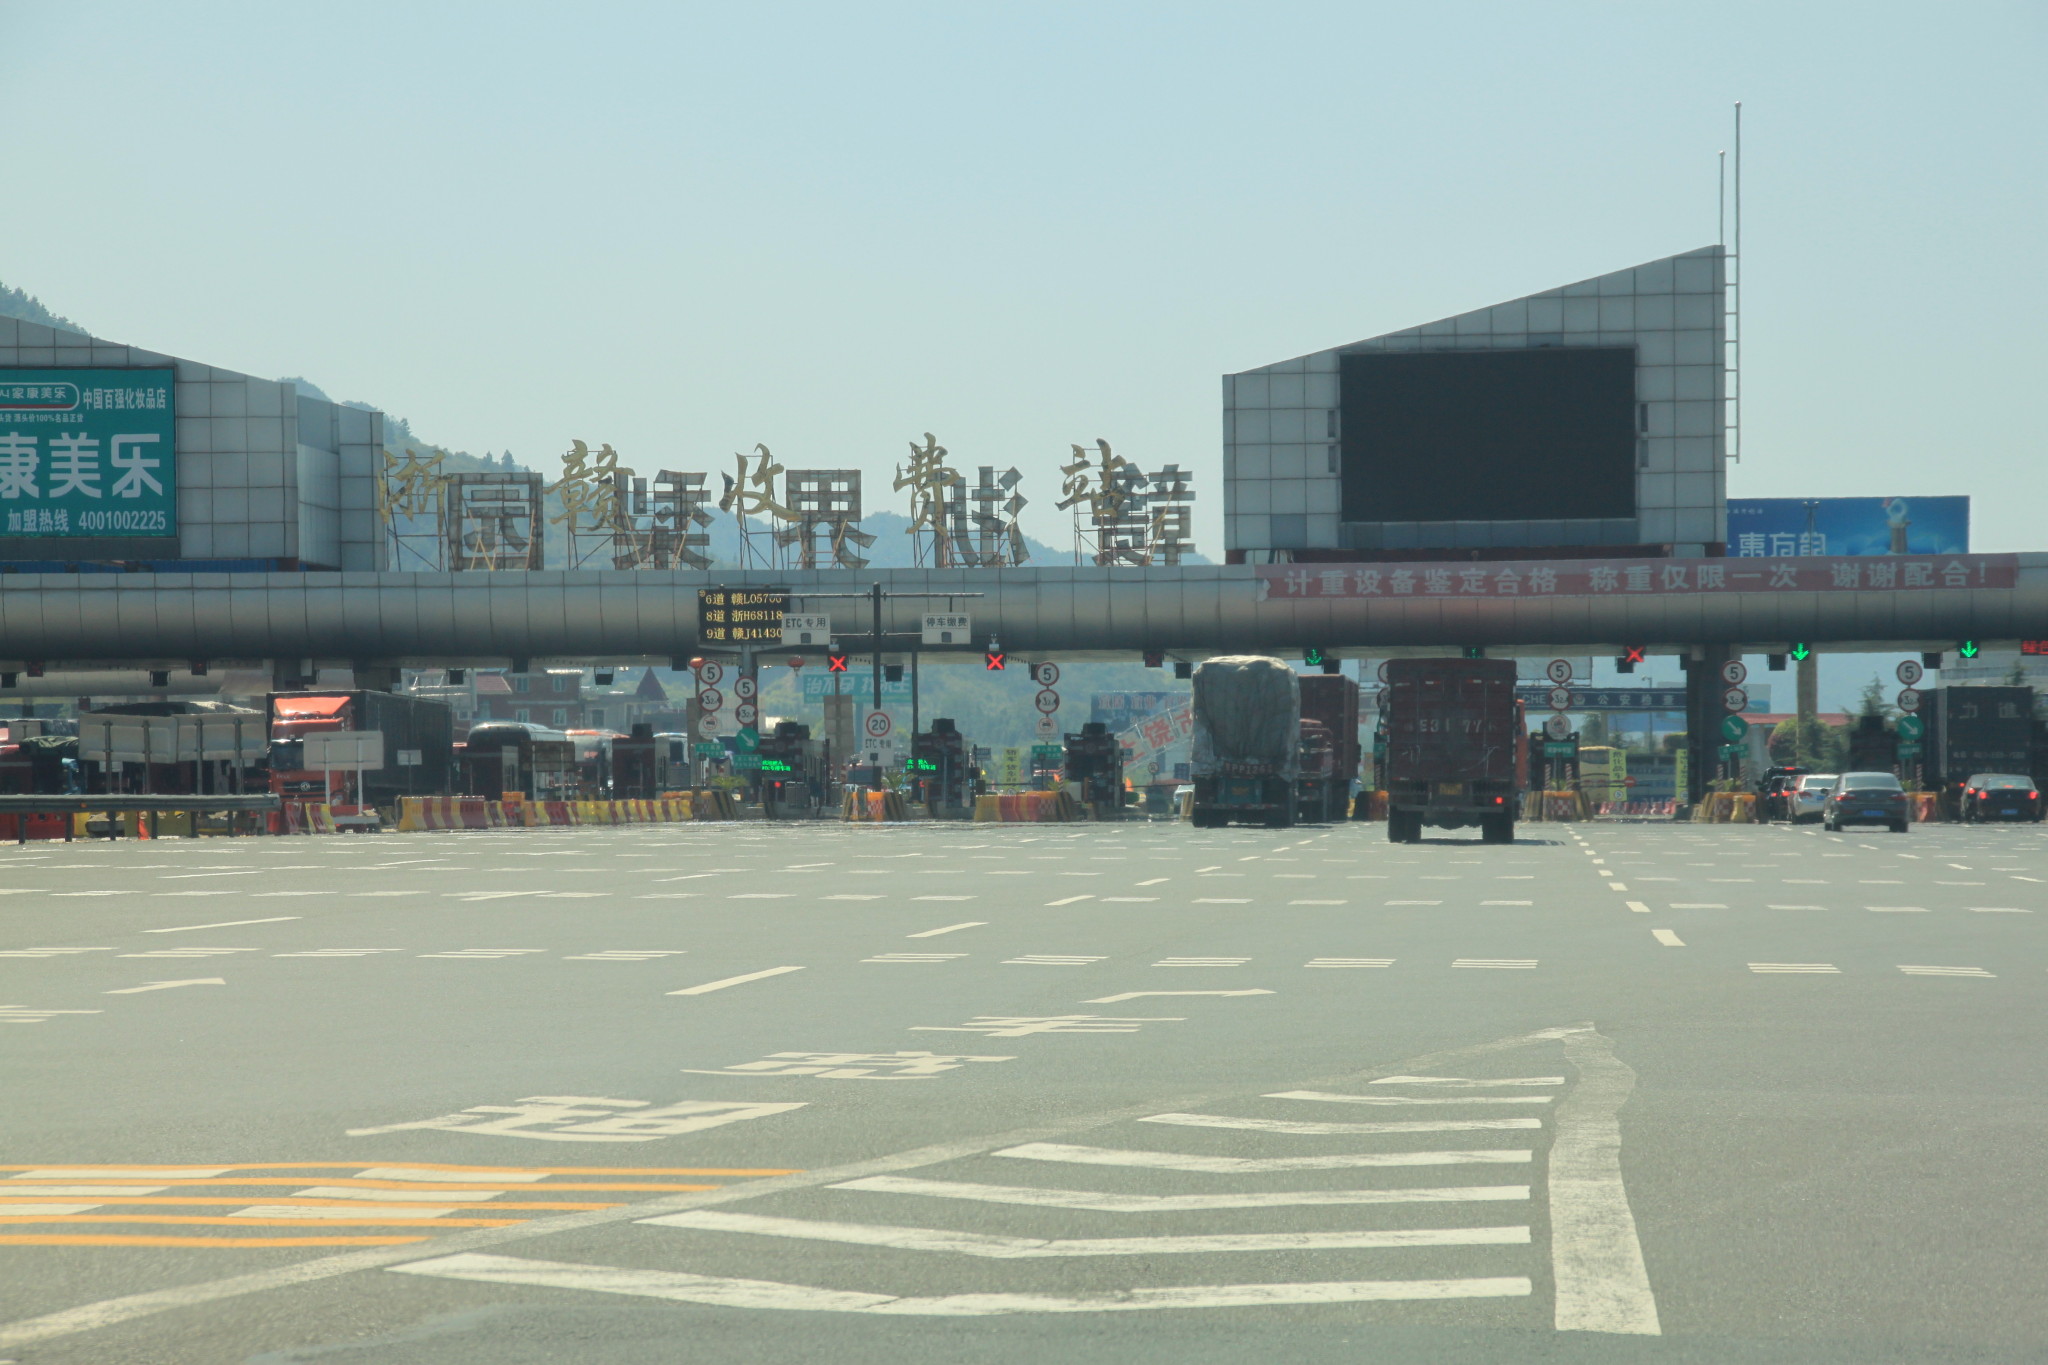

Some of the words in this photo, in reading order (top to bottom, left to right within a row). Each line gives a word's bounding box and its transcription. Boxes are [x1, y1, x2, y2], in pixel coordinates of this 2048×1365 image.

[83, 388, 166, 410] 中国百强化妆品店
[0, 432, 163, 498] 康美乐
[8, 508, 70, 532] 加盟热线
[79, 510, 166, 530] 4001002225
[1284, 567, 1558, 596] 计重设备鉴定合格
[1588, 563, 1799, 593] 称重仅限一次
[705, 592, 725, 606] 6道
[706, 609, 726, 622] 8道
[732, 609, 783, 622] 浙H68118
[785, 618, 802, 628] ETC
[805, 617, 826, 628] 专用
[926, 616, 968, 627] 停车缴费
[706, 627, 726, 640] 9道
[732, 627, 783, 640] 赣J41430
[707, 666, 715, 680] 5
[1043, 667, 1052, 681] 5
[1555, 664, 1564, 678] 5
[1730, 666, 1739, 680] 5
[1904, 665, 1914, 680] 5
[742, 681, 750, 695] 5
[871, 719, 886, 731] 20
